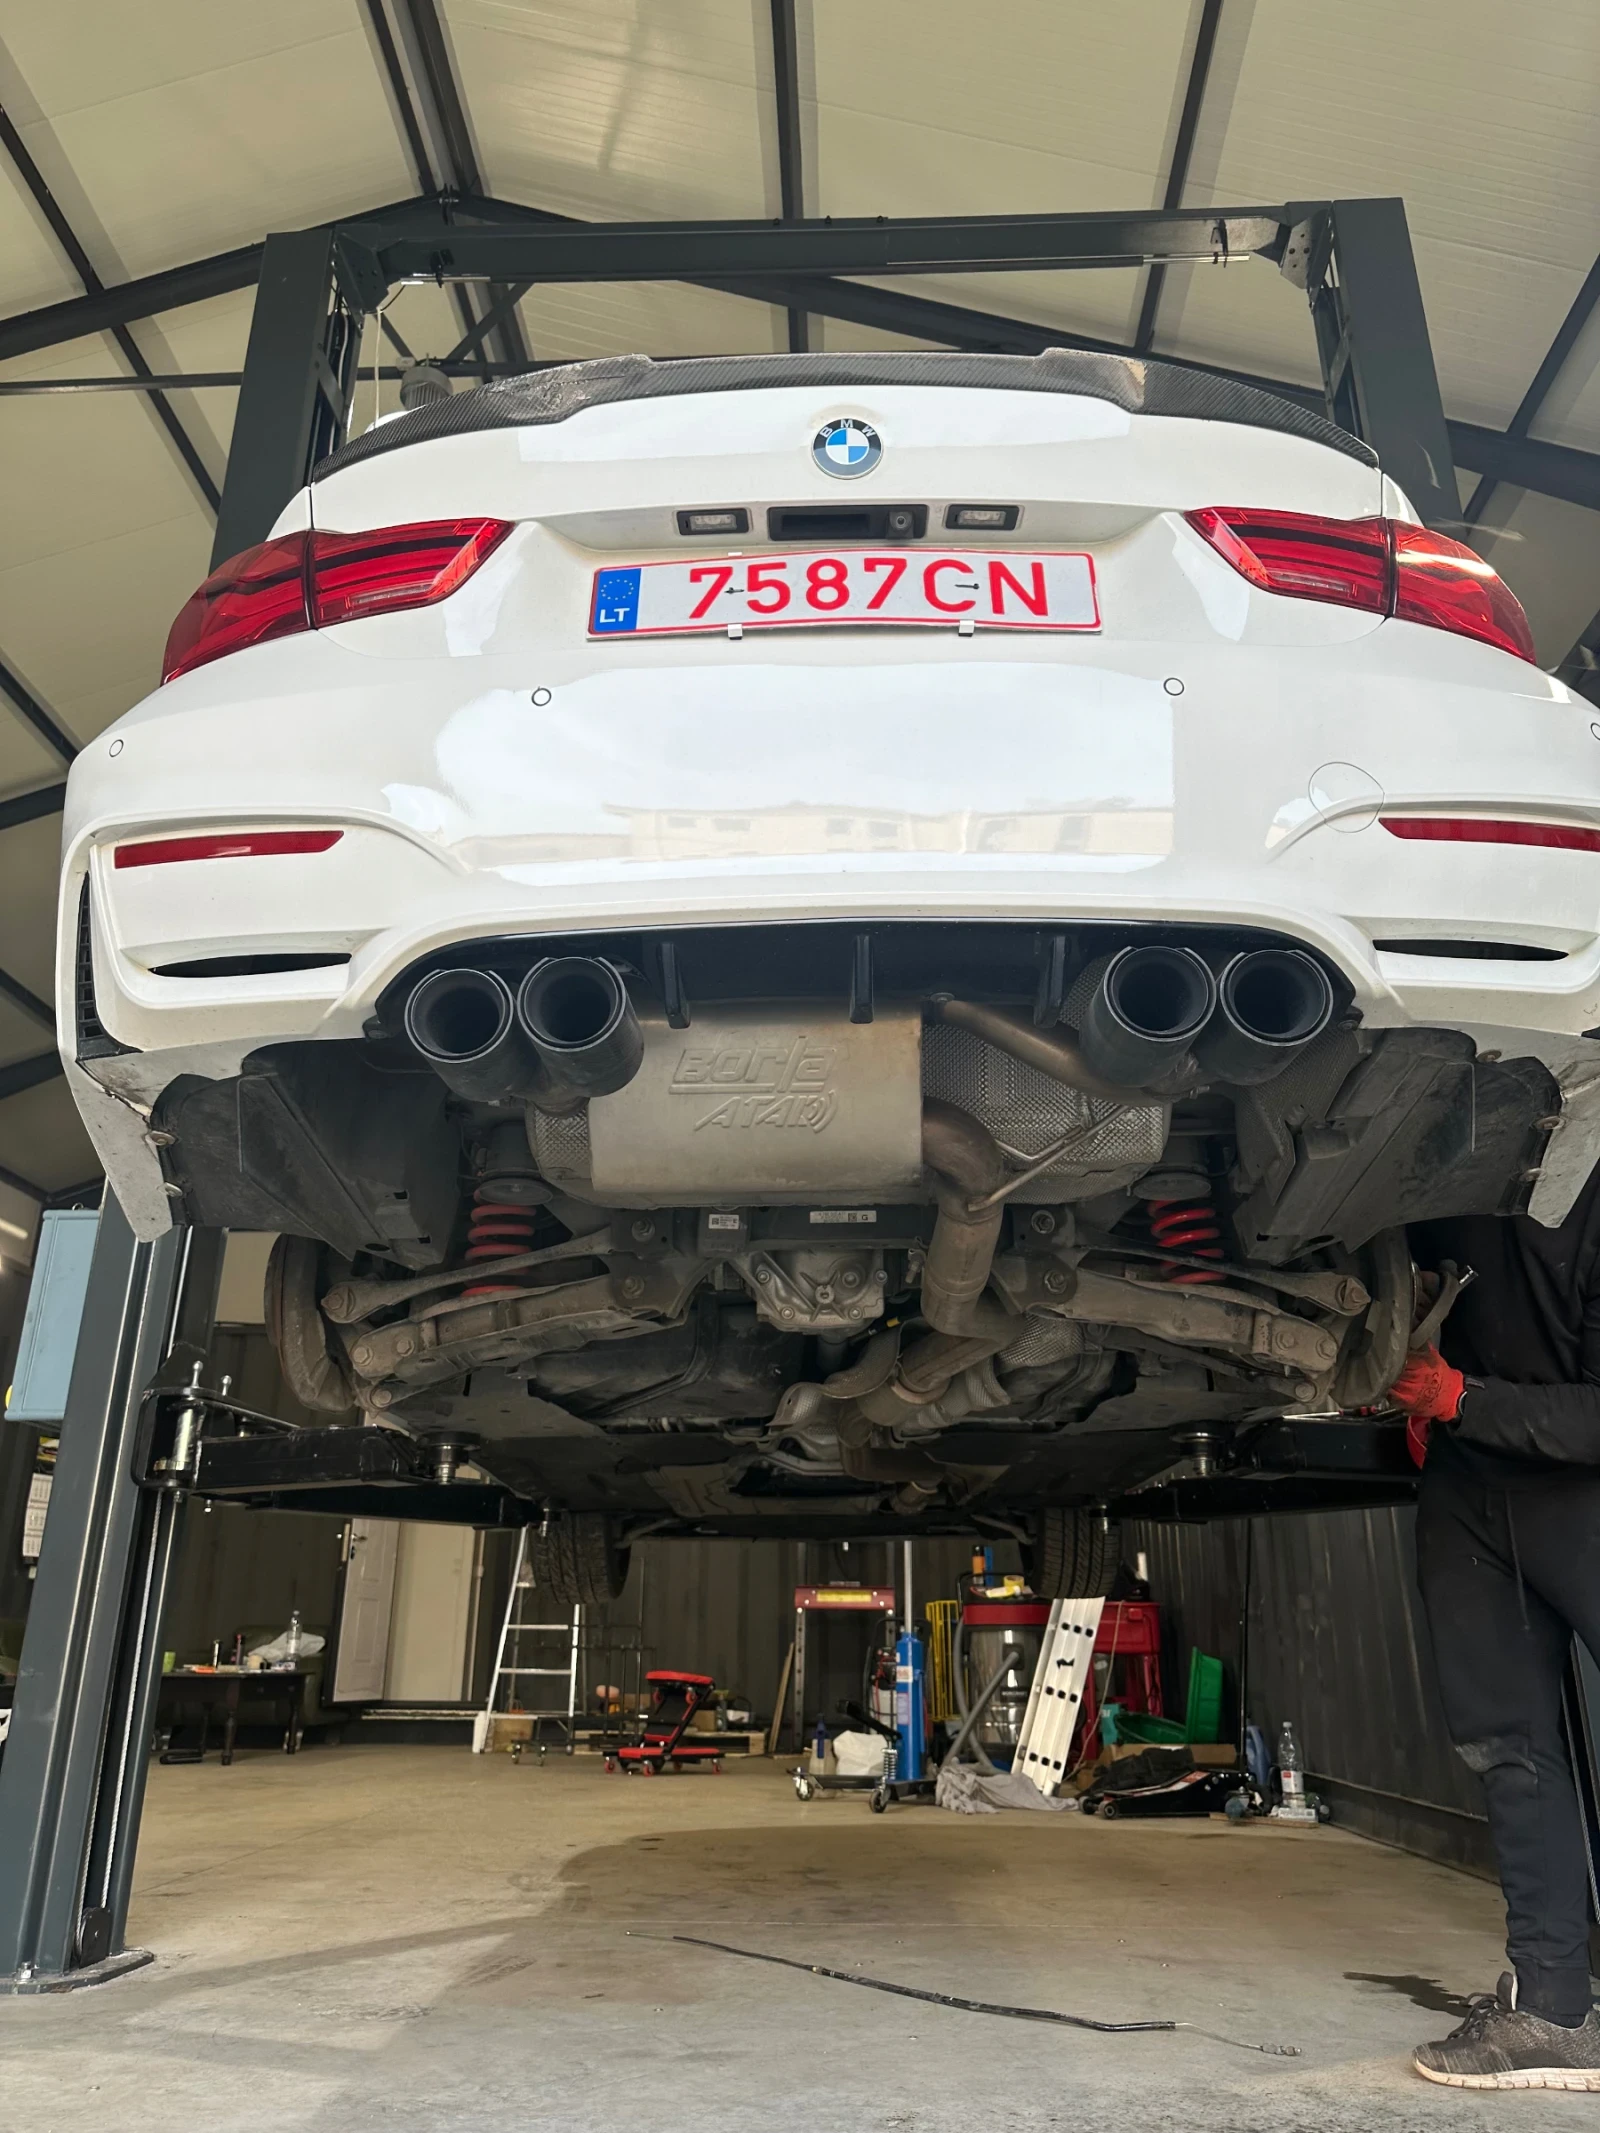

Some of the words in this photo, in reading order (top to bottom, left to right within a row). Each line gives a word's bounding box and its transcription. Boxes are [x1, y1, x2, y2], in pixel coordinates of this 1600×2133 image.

[820, 418, 876, 438] BMW
[689, 557, 1048, 618] 7587CN
[600, 607, 630, 623] LT
